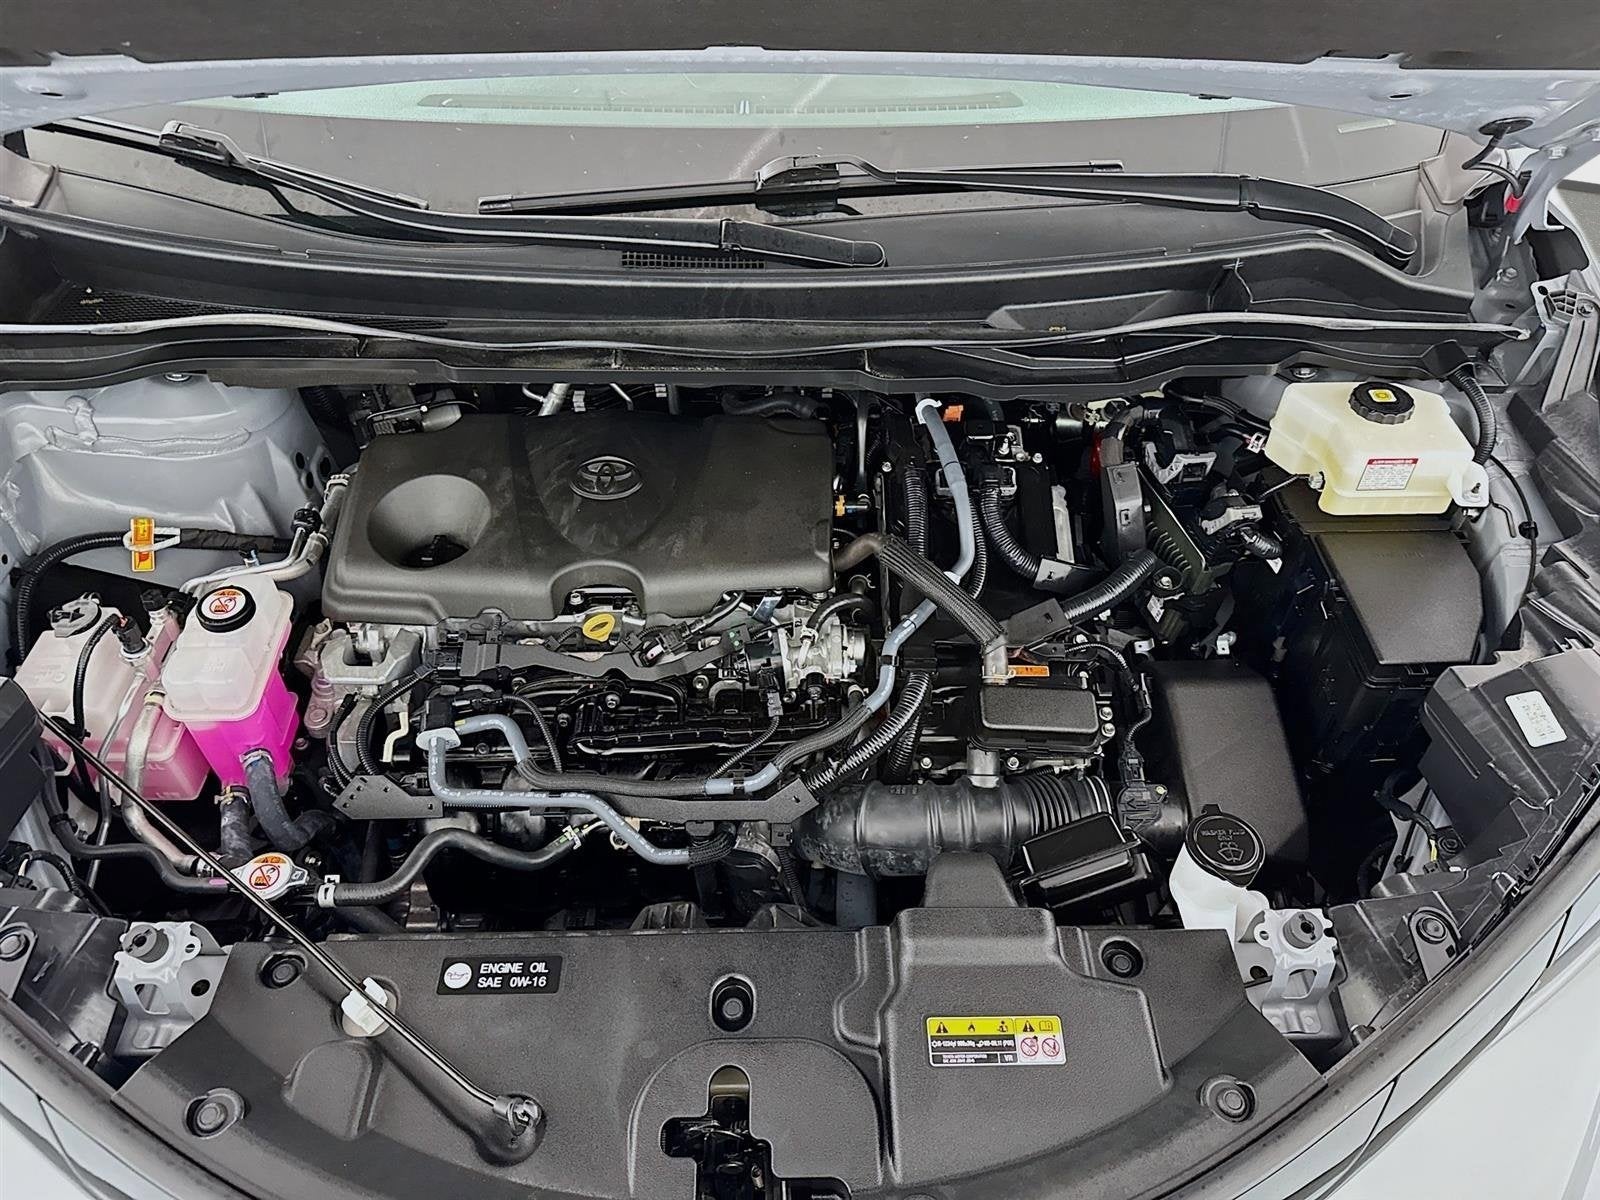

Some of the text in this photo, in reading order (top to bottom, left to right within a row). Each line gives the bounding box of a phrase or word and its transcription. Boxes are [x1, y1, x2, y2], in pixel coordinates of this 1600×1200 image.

[480, 962, 549, 974] ENGINE OIL
[477, 976, 547, 988] SAE 0W-16
